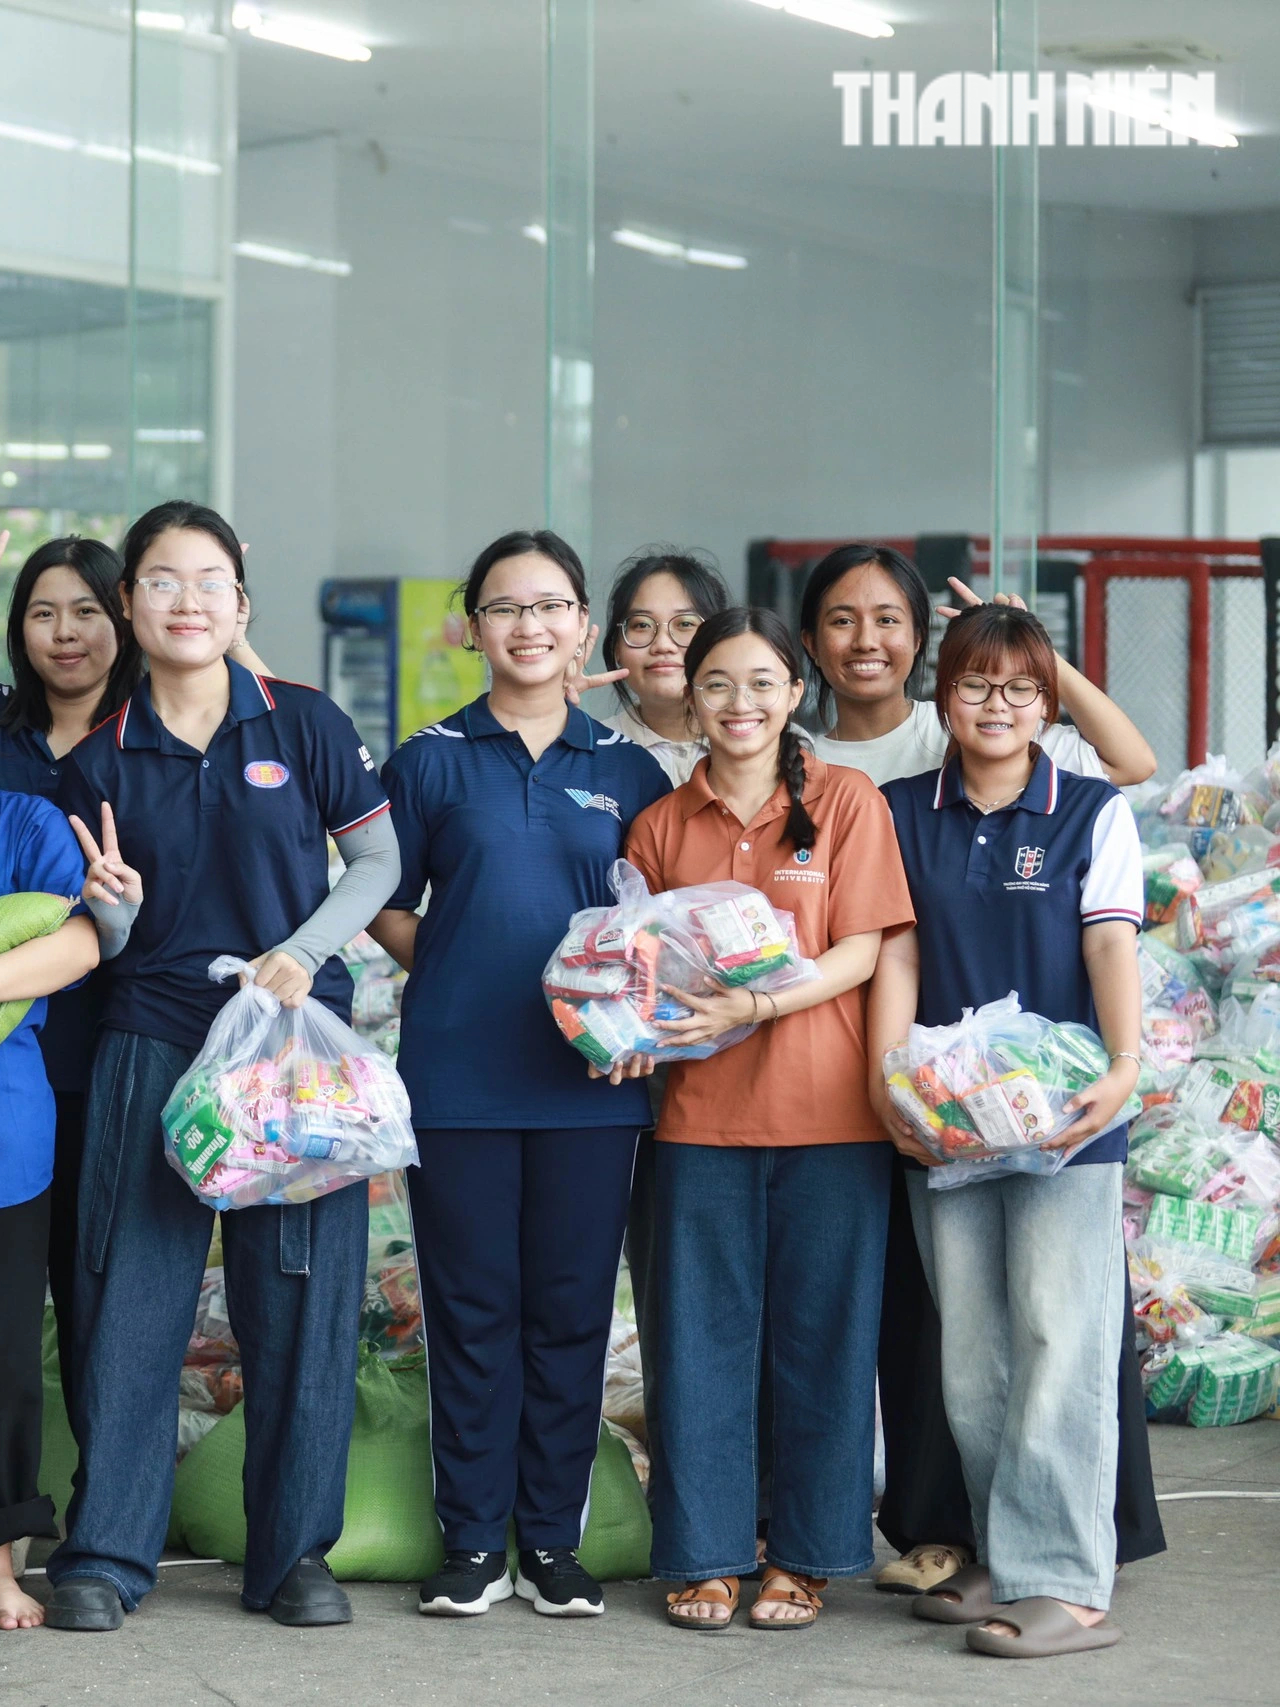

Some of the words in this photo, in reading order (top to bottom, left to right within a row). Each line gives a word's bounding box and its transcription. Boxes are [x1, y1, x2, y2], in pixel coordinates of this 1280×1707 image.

[774, 869, 826, 878] INTERNATIONAL
[773, 875, 826, 884] UNIVERSITY
[188, 1132, 228, 1177] Vinamilk
